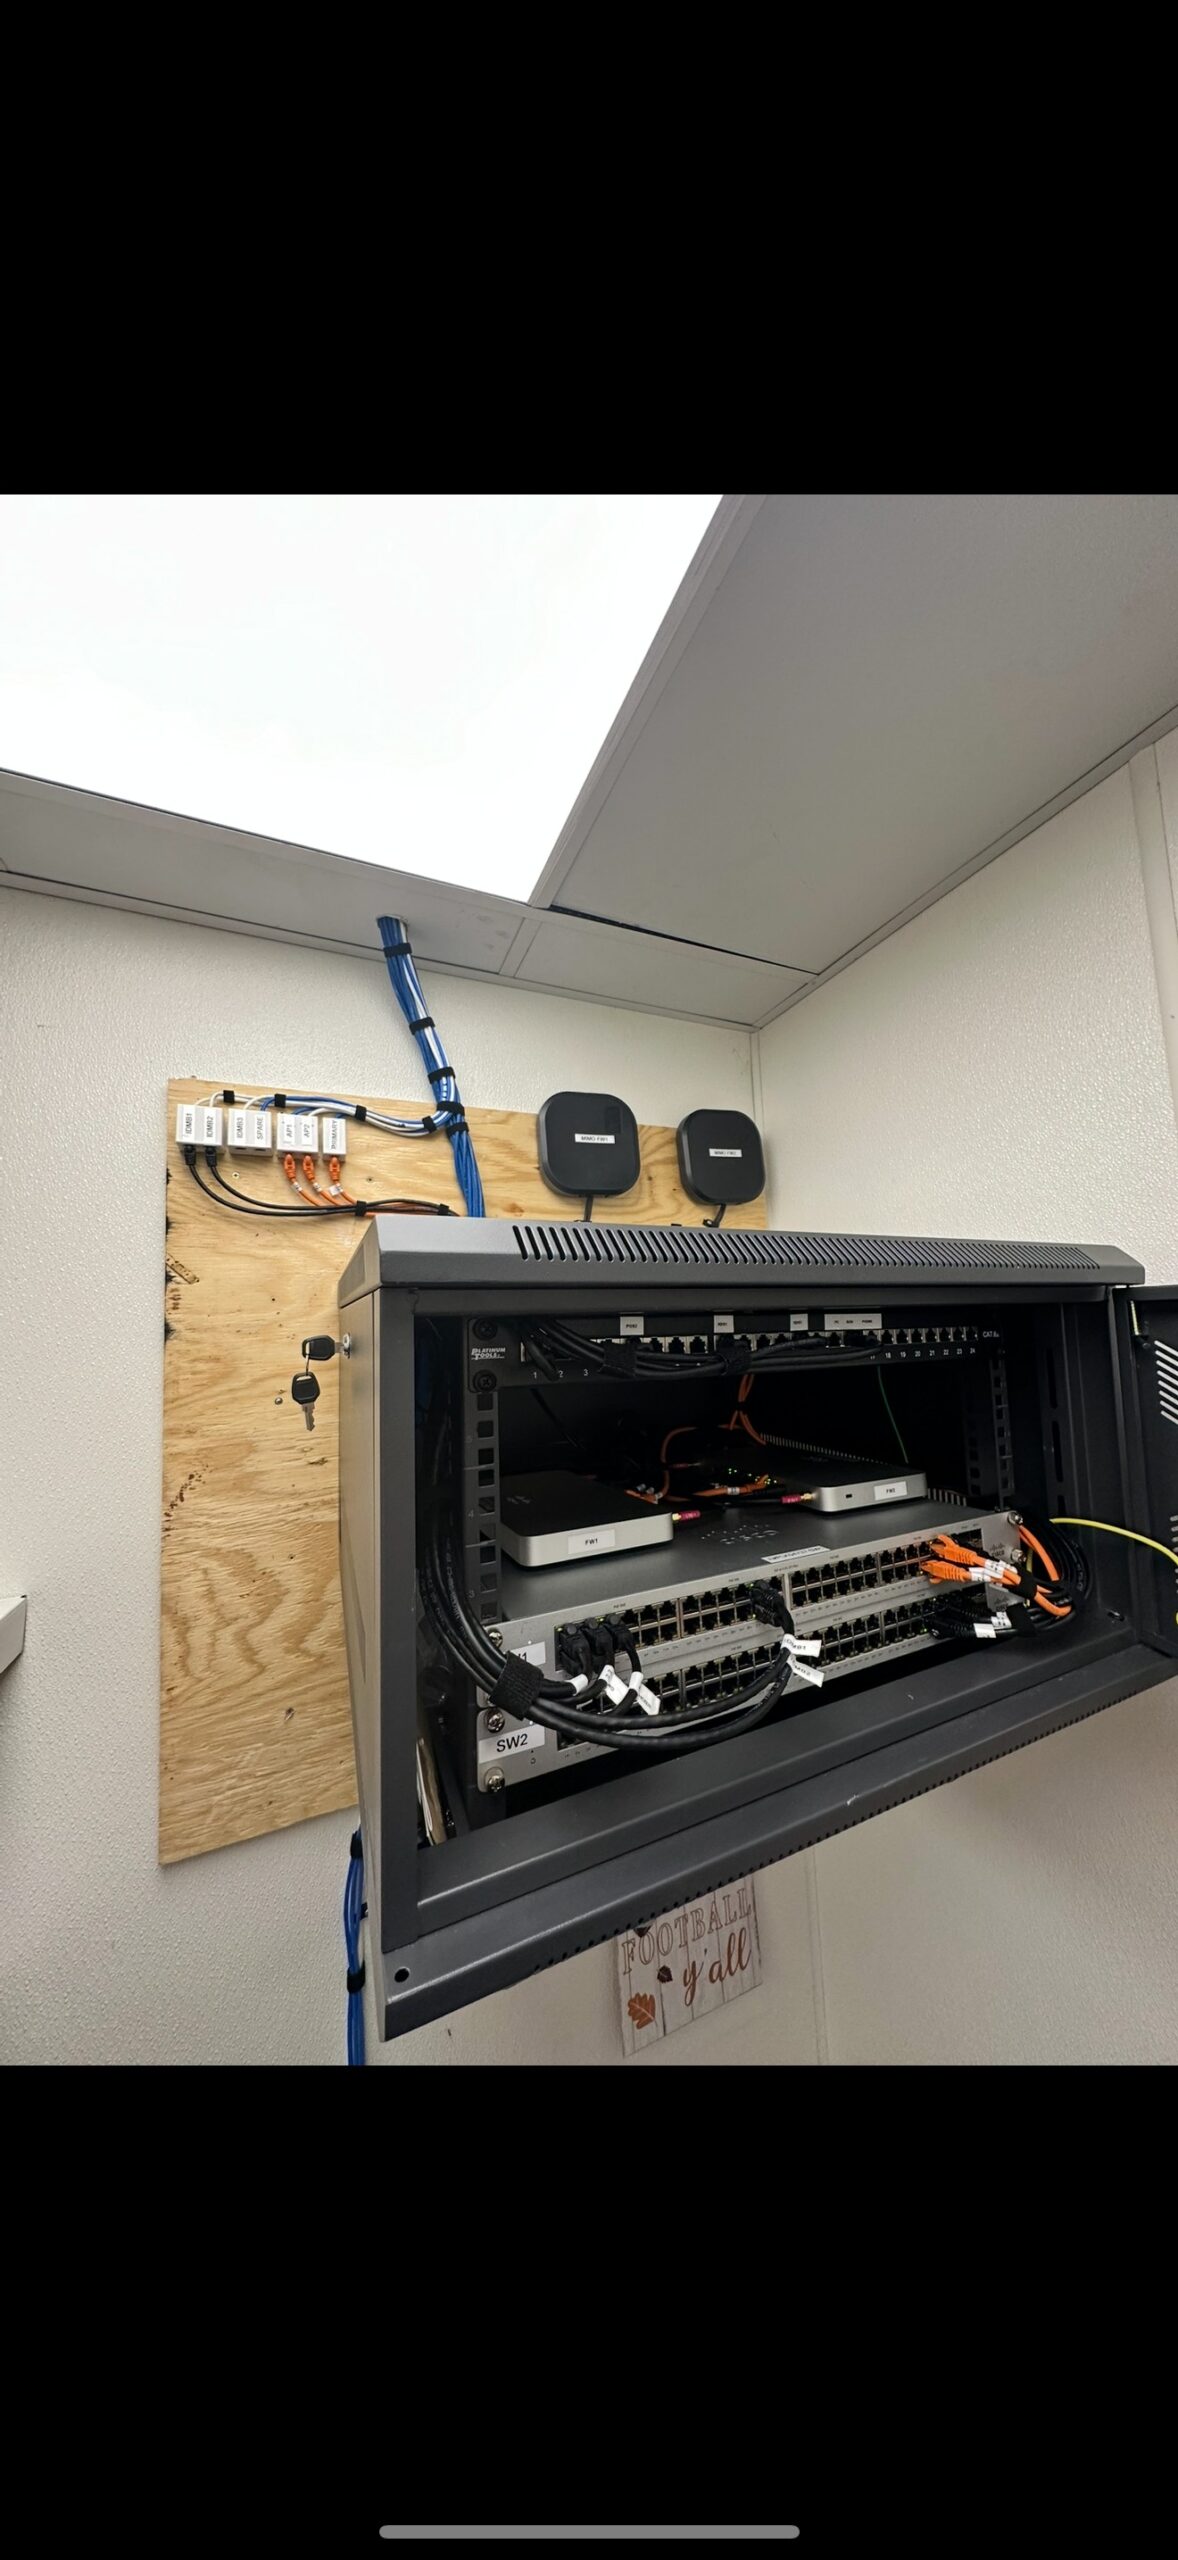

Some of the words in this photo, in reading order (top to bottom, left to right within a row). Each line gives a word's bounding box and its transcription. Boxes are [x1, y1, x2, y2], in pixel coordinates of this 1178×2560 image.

[256, 1116, 264, 1140] SPARE
[303, 1124, 311, 1138] AP2
[471, 1347, 506, 1356] PLATINUM
[559, 1370, 564, 1378] 2
[583, 1368, 588, 1377] 3
[584, 1538, 598, 1546] FW1
[496, 1733, 528, 1753] SW2
[621, 1887, 752, 1976] FOOTBALL
[682, 1926, 752, 2007] y'all
